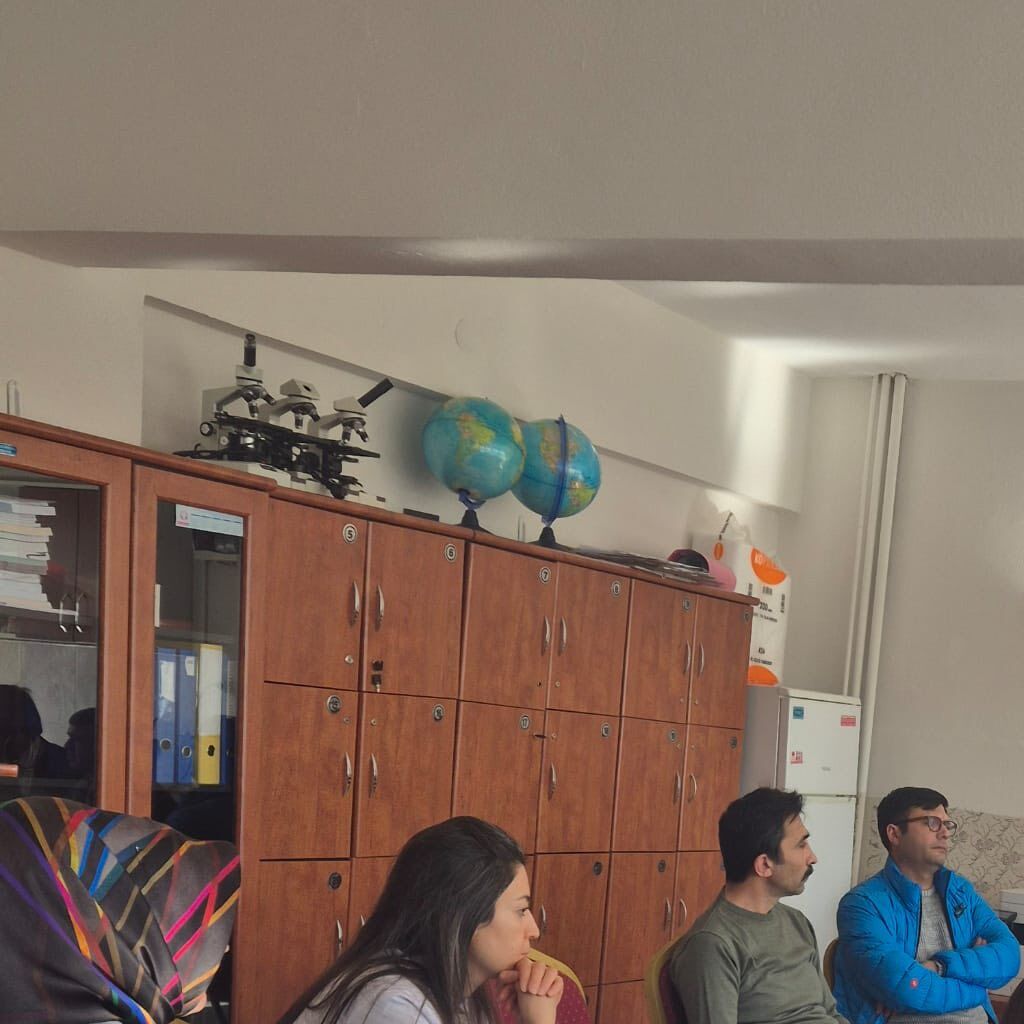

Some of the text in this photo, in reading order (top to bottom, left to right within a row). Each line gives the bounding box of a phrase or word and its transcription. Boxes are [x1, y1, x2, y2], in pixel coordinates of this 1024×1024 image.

[347, 530, 353, 539] 5
[448, 549, 453, 557] 6
[543, 571, 548, 579] 7
